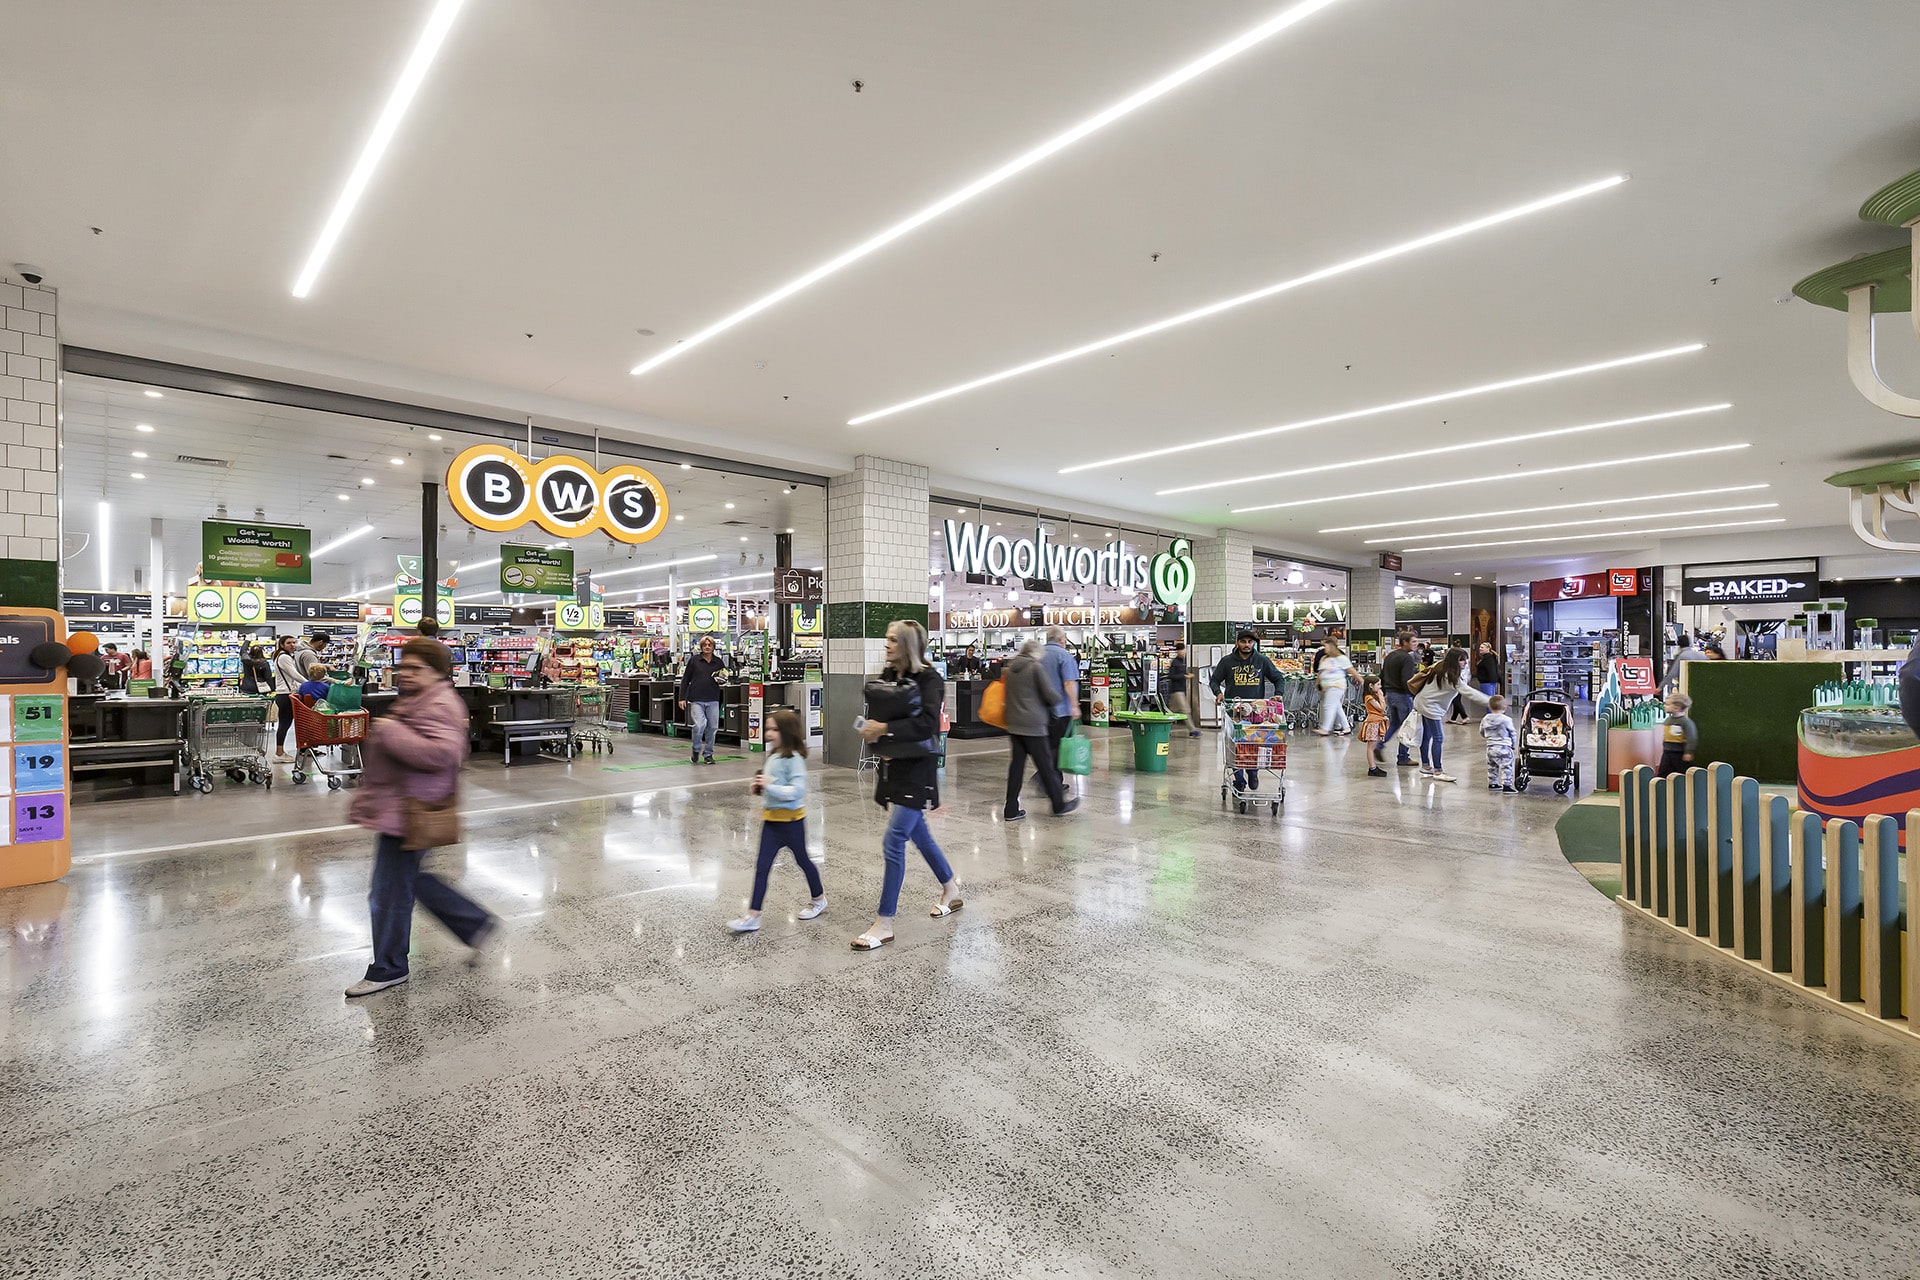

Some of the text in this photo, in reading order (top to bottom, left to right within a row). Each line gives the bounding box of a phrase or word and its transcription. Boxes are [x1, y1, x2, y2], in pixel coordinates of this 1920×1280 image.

[506, 459, 530, 484] BEER
[484, 472, 645, 519] B W S
[261, 540, 291, 548] worth!
[943, 519, 1149, 591] Woolworths
[408, 560, 417, 570] 2
[1612, 573, 1635, 588] tsg
[1709, 578, 1788, 597] BAKED
[99, 601, 112, 612] 6
[307, 607, 316, 617] 5
[566, 608, 580, 619] 1/2
[1252, 602, 1300, 623] UIT
[469, 612, 477, 620] 4
[1043, 609, 1123, 626] UTCHER
[1622, 663, 1651, 686] tsg
[21, 805, 55, 820] $13
